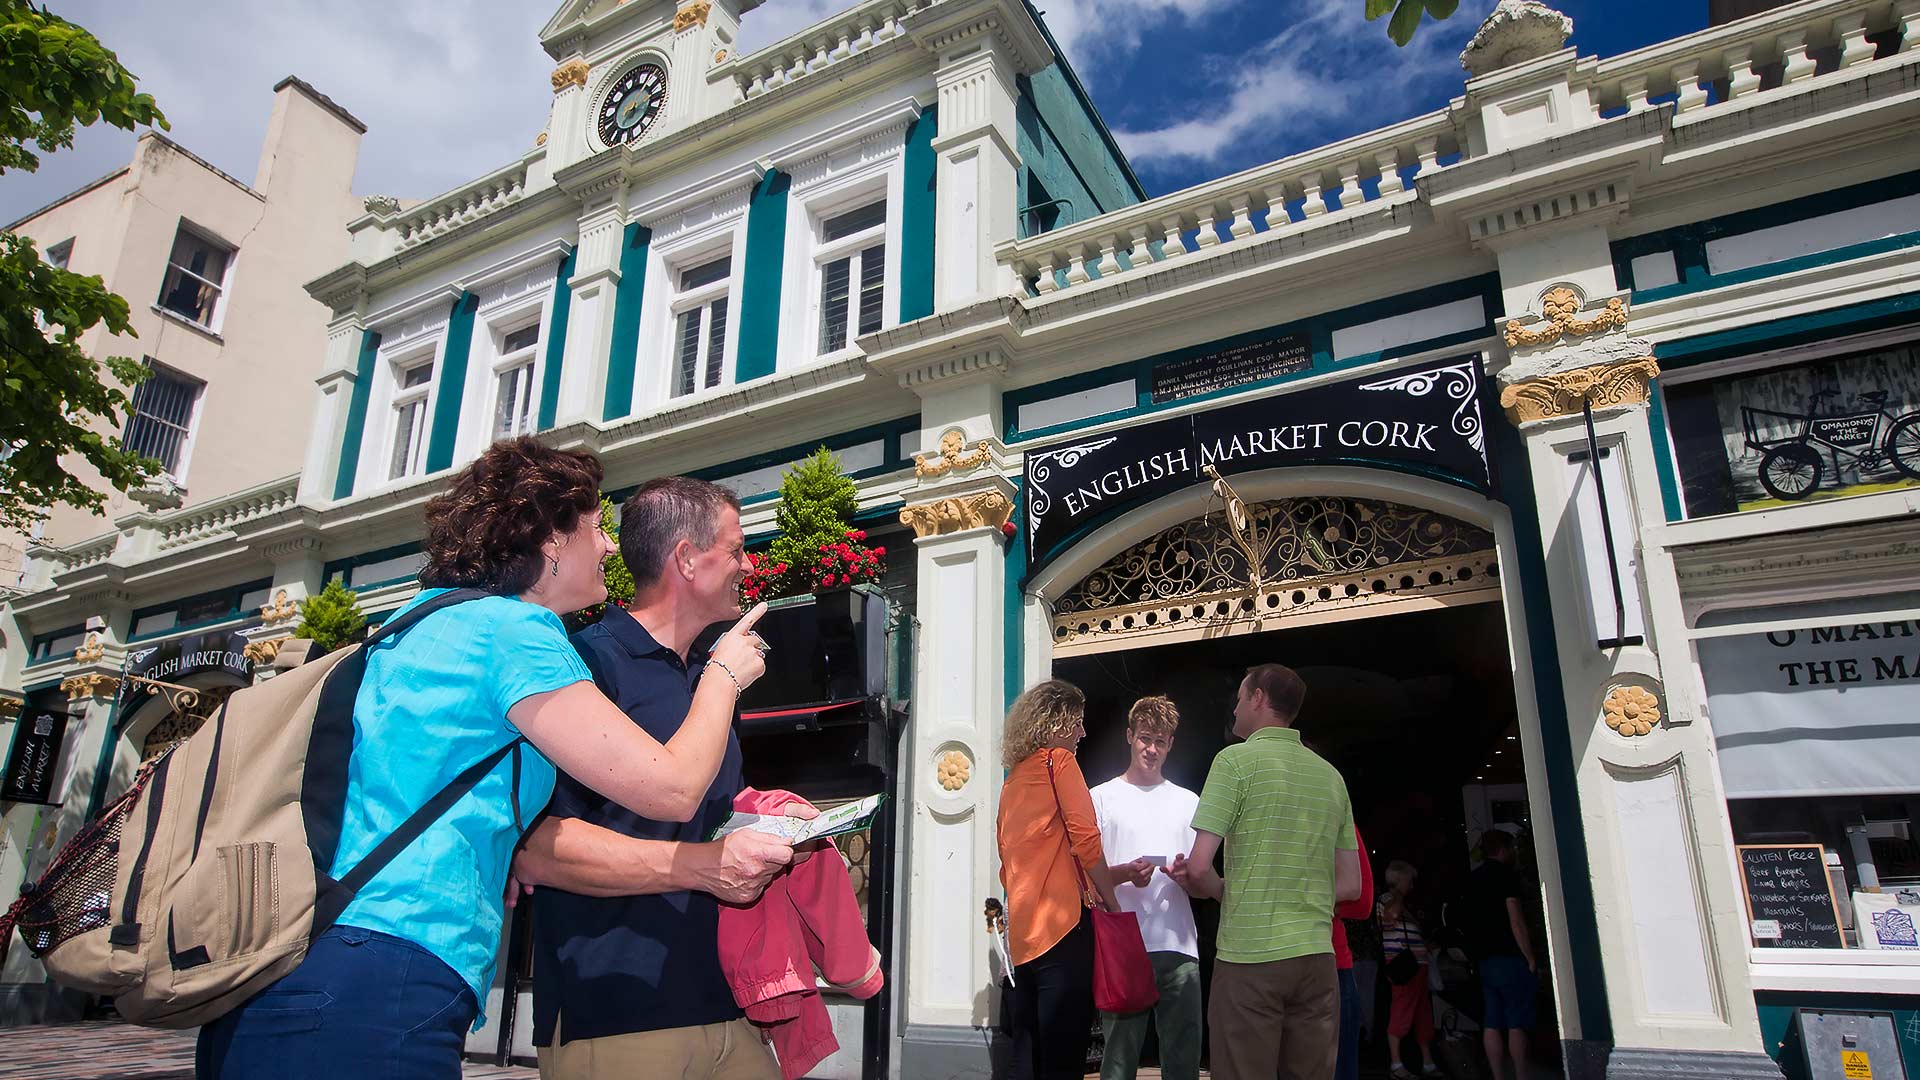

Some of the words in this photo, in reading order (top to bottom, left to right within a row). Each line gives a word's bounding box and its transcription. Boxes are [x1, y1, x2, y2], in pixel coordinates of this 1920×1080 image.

[1157, 376, 1181, 387] DANIEL
[1183, 369, 1212, 380] VINCENT
[1278, 346, 1306, 358] MAYOR
[1186, 383, 1221, 396] TERENCE
[1820, 418, 1874, 431] OMAHONYS
[1830, 431, 1868, 441] MARKET
[1836, 427, 1858, 435] THE
[1062, 447, 1190, 517] ENGLISH
[1199, 423, 1328, 467] MARKET
[1338, 420, 1439, 452] CORK
[180, 650, 223, 670] MARKET
[223, 651, 251, 674] CORK
[1779, 658, 1862, 686] THE
[16, 740, 36, 790] ENGLISH
[32, 740, 51, 792] MARKET
